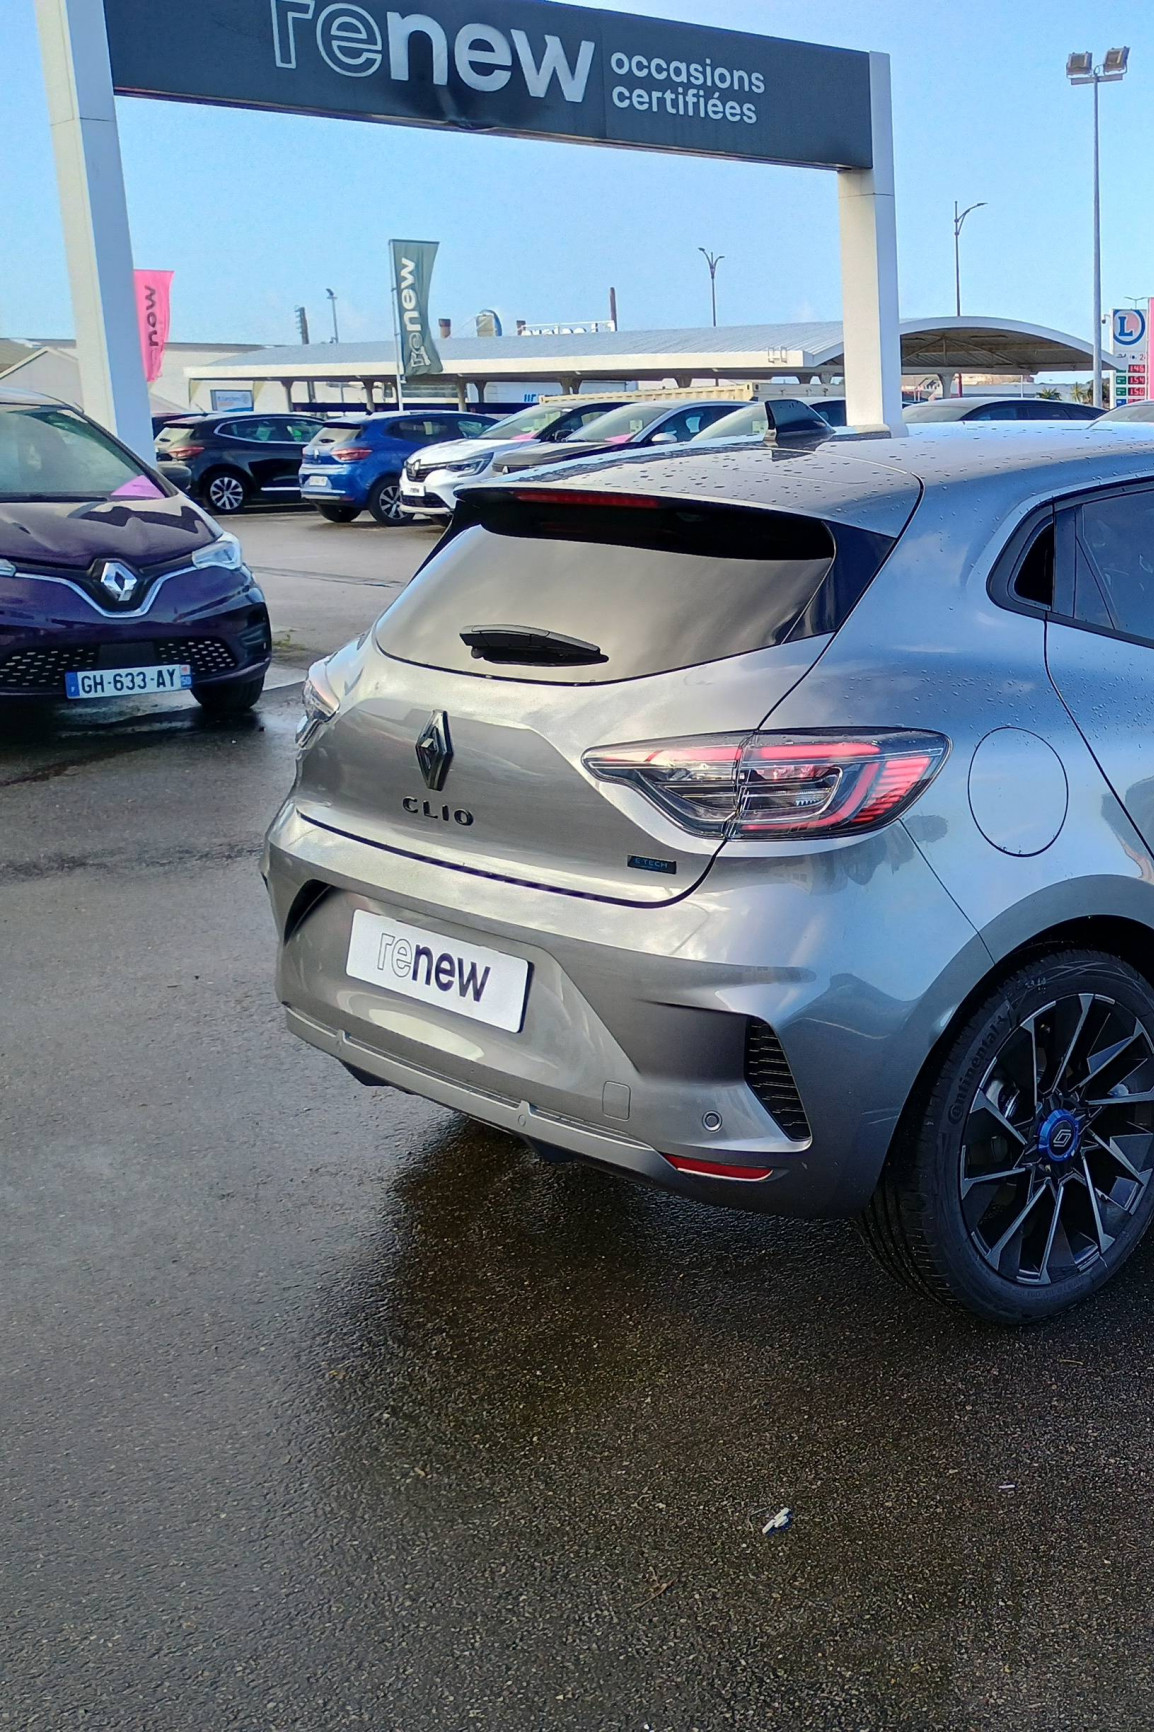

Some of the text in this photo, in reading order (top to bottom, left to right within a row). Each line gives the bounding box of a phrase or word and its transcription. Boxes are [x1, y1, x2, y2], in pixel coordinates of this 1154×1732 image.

[270, 0, 596, 103] renew
[611, 52, 765, 94] occasions
[611, 83, 758, 125] certifiées
[80, 669, 177, 695] GH-633-AY
[402, 796, 475, 827] CLIO
[376, 932, 491, 1003] renew
[948, 1022, 1001, 1126] Continental
